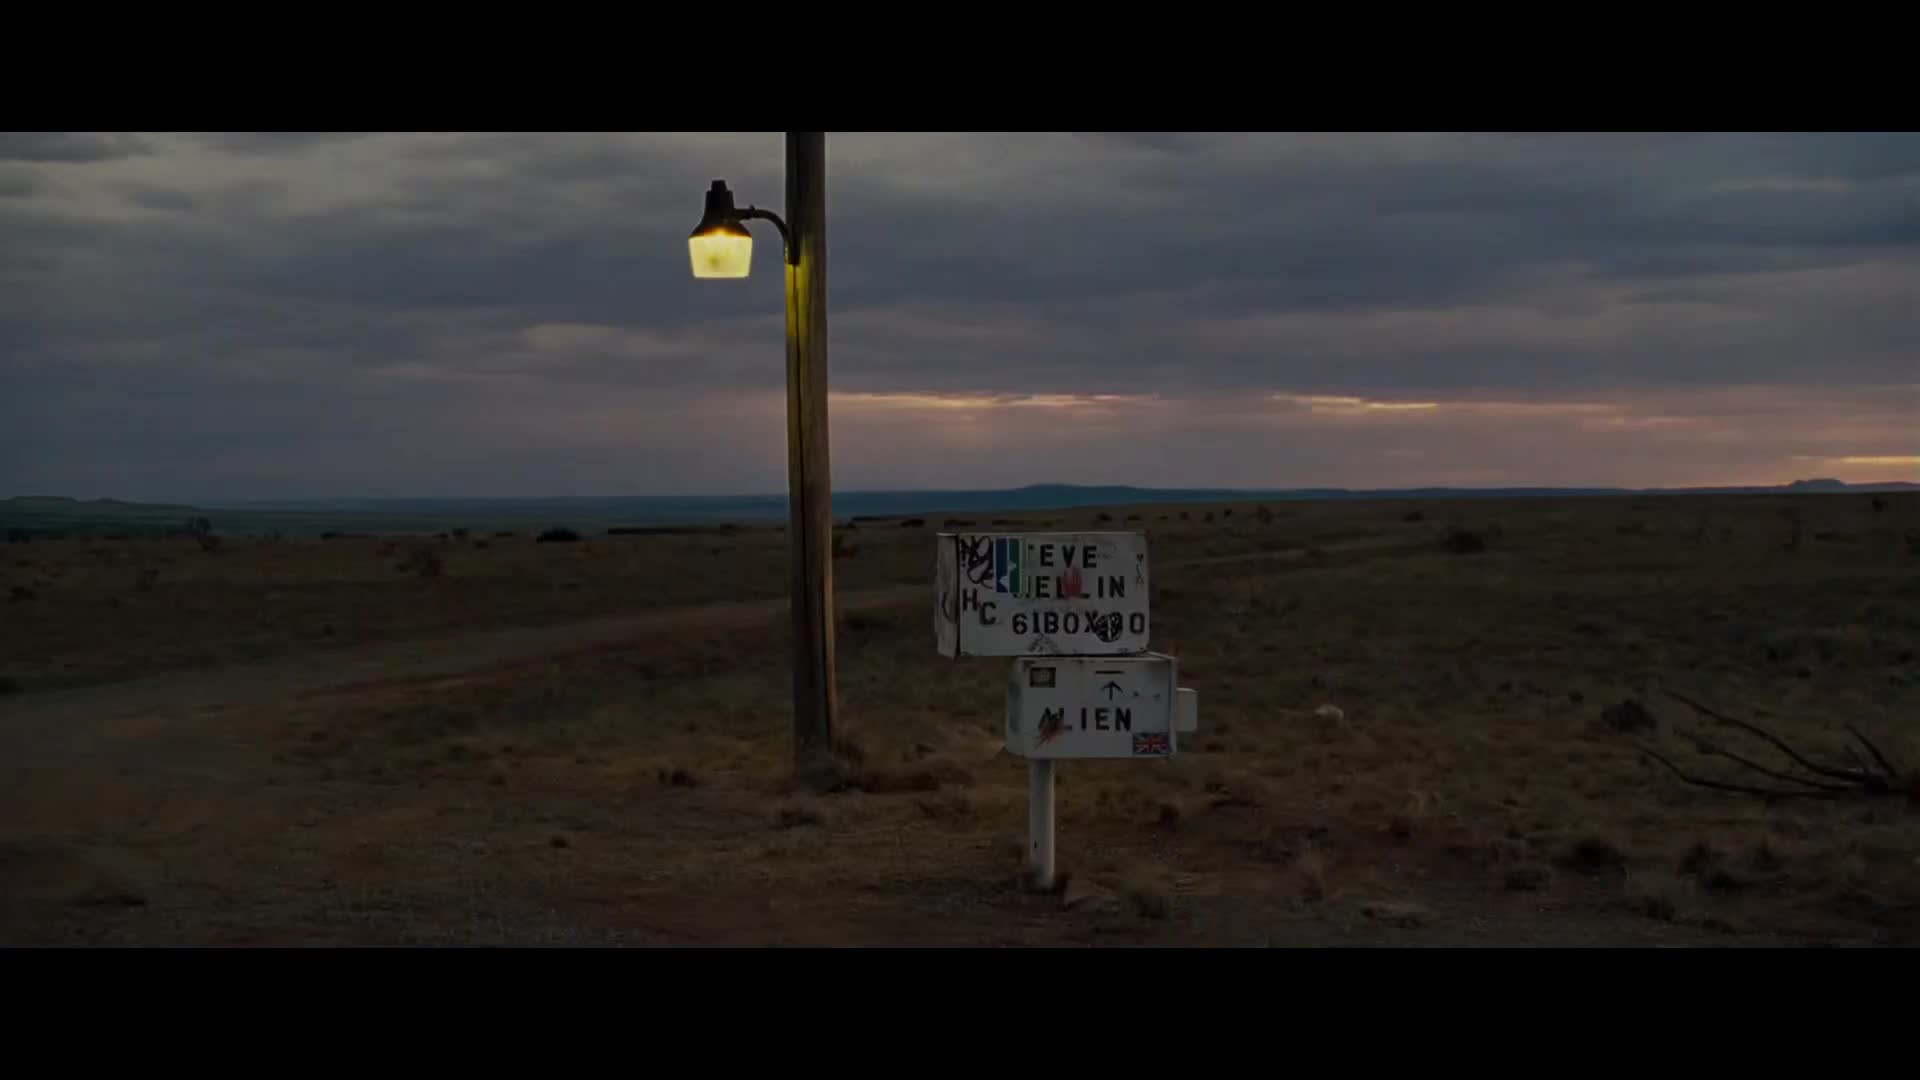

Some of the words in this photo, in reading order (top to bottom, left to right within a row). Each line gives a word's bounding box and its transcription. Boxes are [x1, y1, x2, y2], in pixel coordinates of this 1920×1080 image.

[1027, 544, 1097, 569] EVE
[1013, 575, 1125, 599] EIN
[1038, 707, 1132, 731] ALIEN
